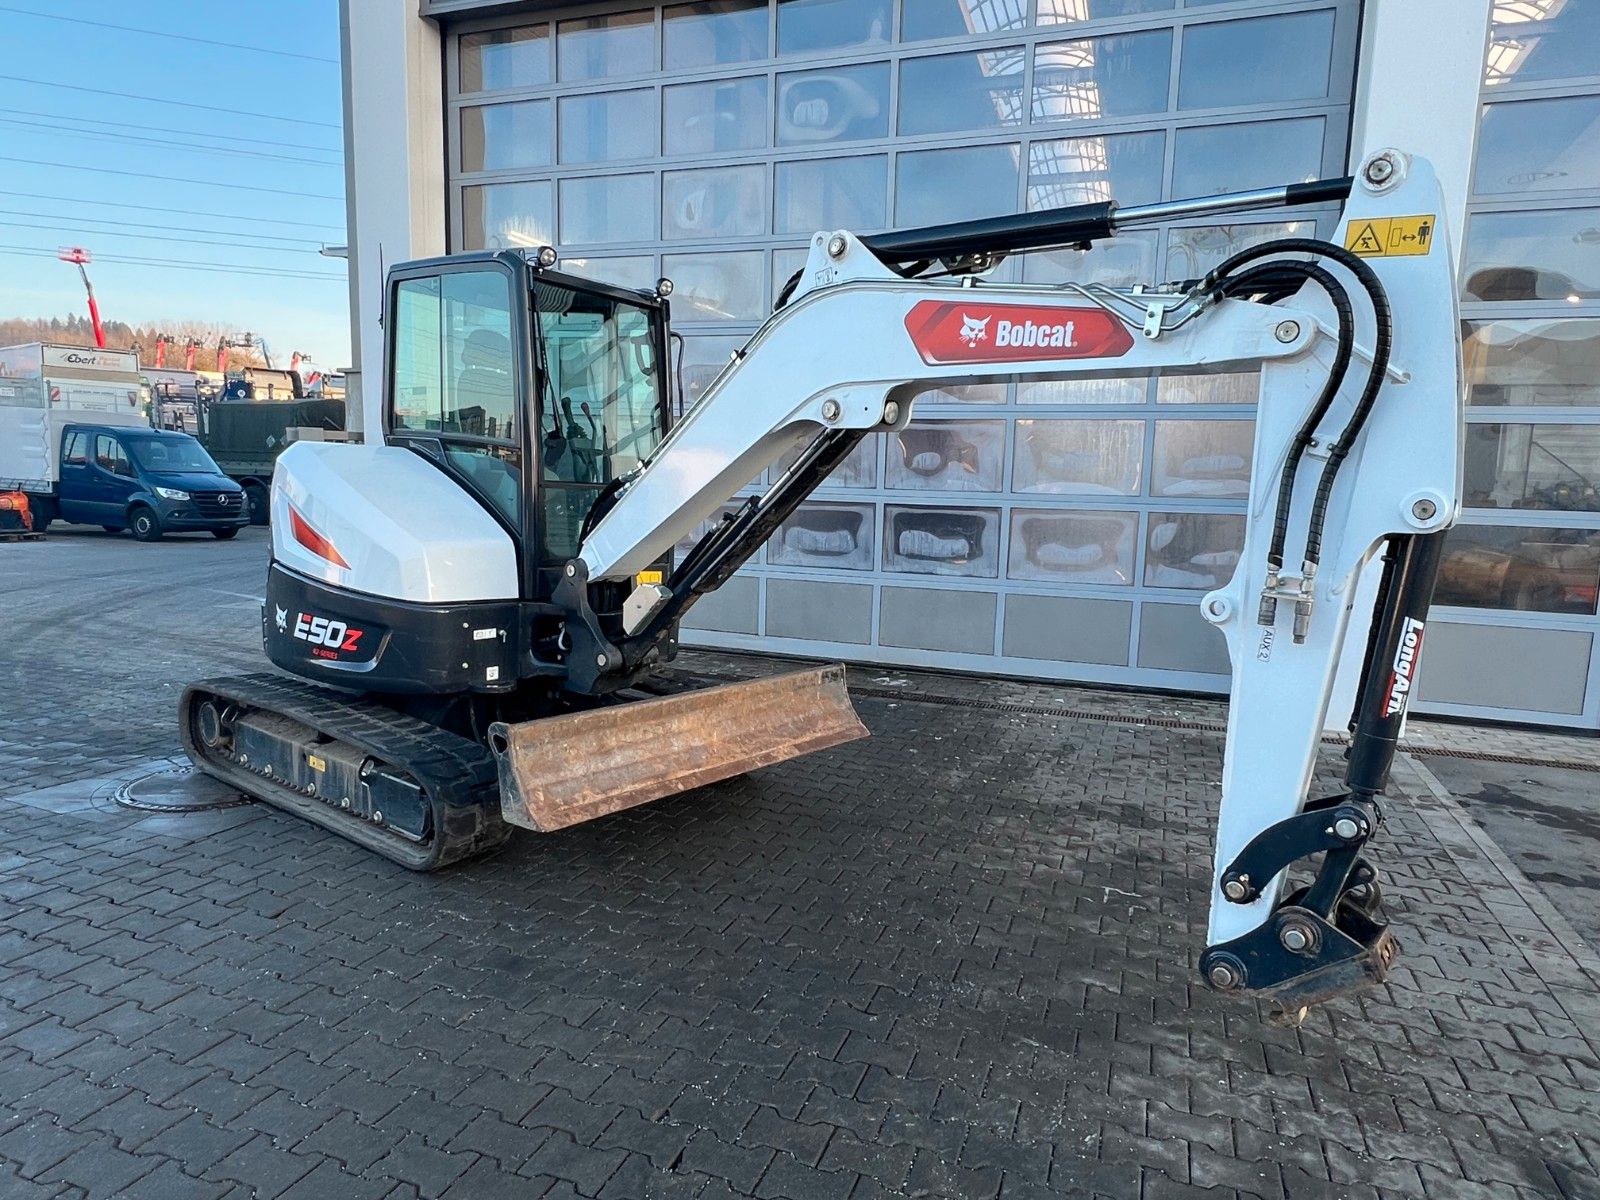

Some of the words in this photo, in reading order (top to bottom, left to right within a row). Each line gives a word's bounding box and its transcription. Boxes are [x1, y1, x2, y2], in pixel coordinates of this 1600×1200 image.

[996, 320, 1075, 347] Bobcat
[68, 353, 97, 365] Ebert
[1261, 629, 1273, 651] AUX
[1386, 616, 1424, 716] LongArm
